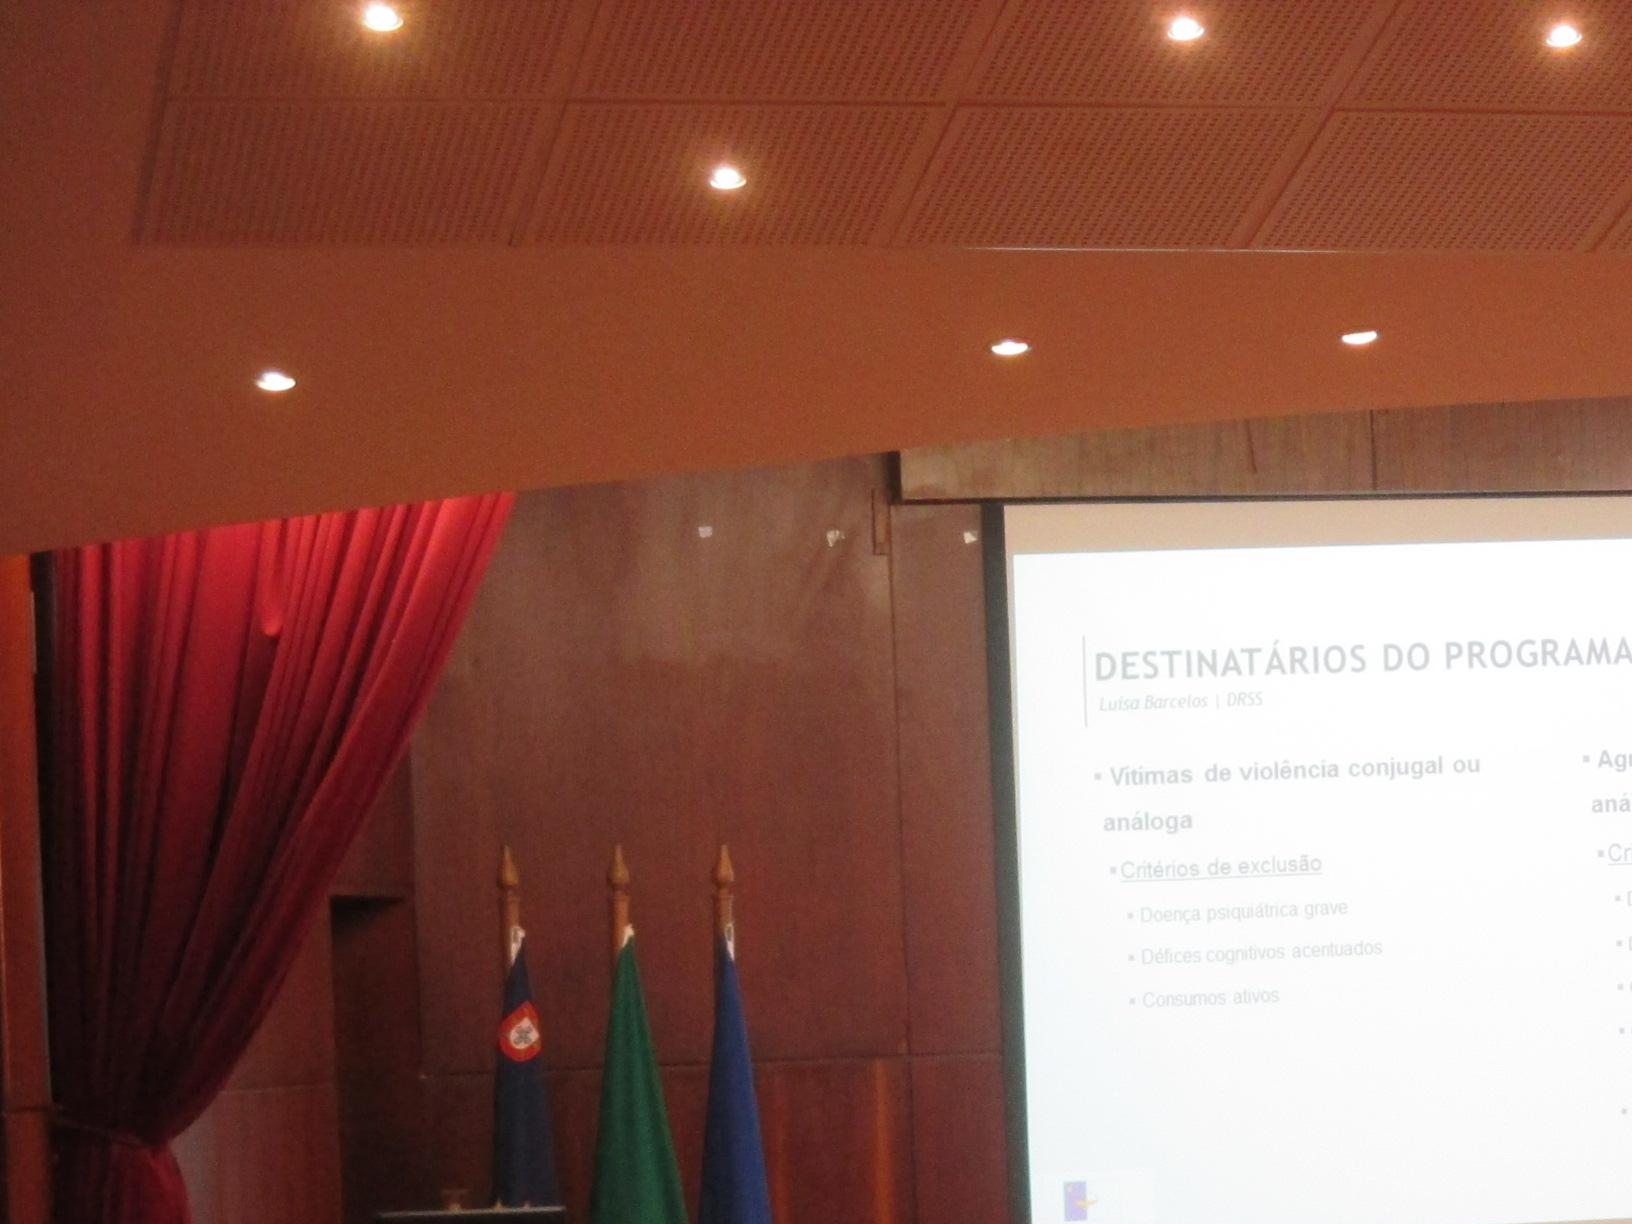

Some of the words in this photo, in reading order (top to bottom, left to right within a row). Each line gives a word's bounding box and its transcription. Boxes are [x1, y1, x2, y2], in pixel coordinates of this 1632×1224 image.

[1096, 640, 1366, 681] DESTINATÁRIOS
[1383, 642, 1430, 672] DO
[1144, 694, 1208, 710] Barcelos
[1227, 691, 1263, 707] DRSS
[1205, 763, 1232, 782] de
[1239, 760, 1339, 781] violência
[1348, 755, 1443, 780] conjugal
[1453, 759, 1480, 773] ou
[1104, 811, 1192, 834] análoga
[1120, 860, 1200, 881] Critérios
[1207, 858, 1232, 878] de
[1237, 854, 1323, 877] exclusão
[1141, 907, 1201, 925] Doença
[1207, 902, 1299, 924] psiquiátrica
[1304, 902, 1348, 920] grave
[1141, 948, 1202, 965] Défices
[1206, 945, 1285, 965] cognitivos
[1292, 940, 1383, 958] acentuados
[1142, 992, 1226, 1008] Consumos
[1233, 989, 1280, 1004] ativos
